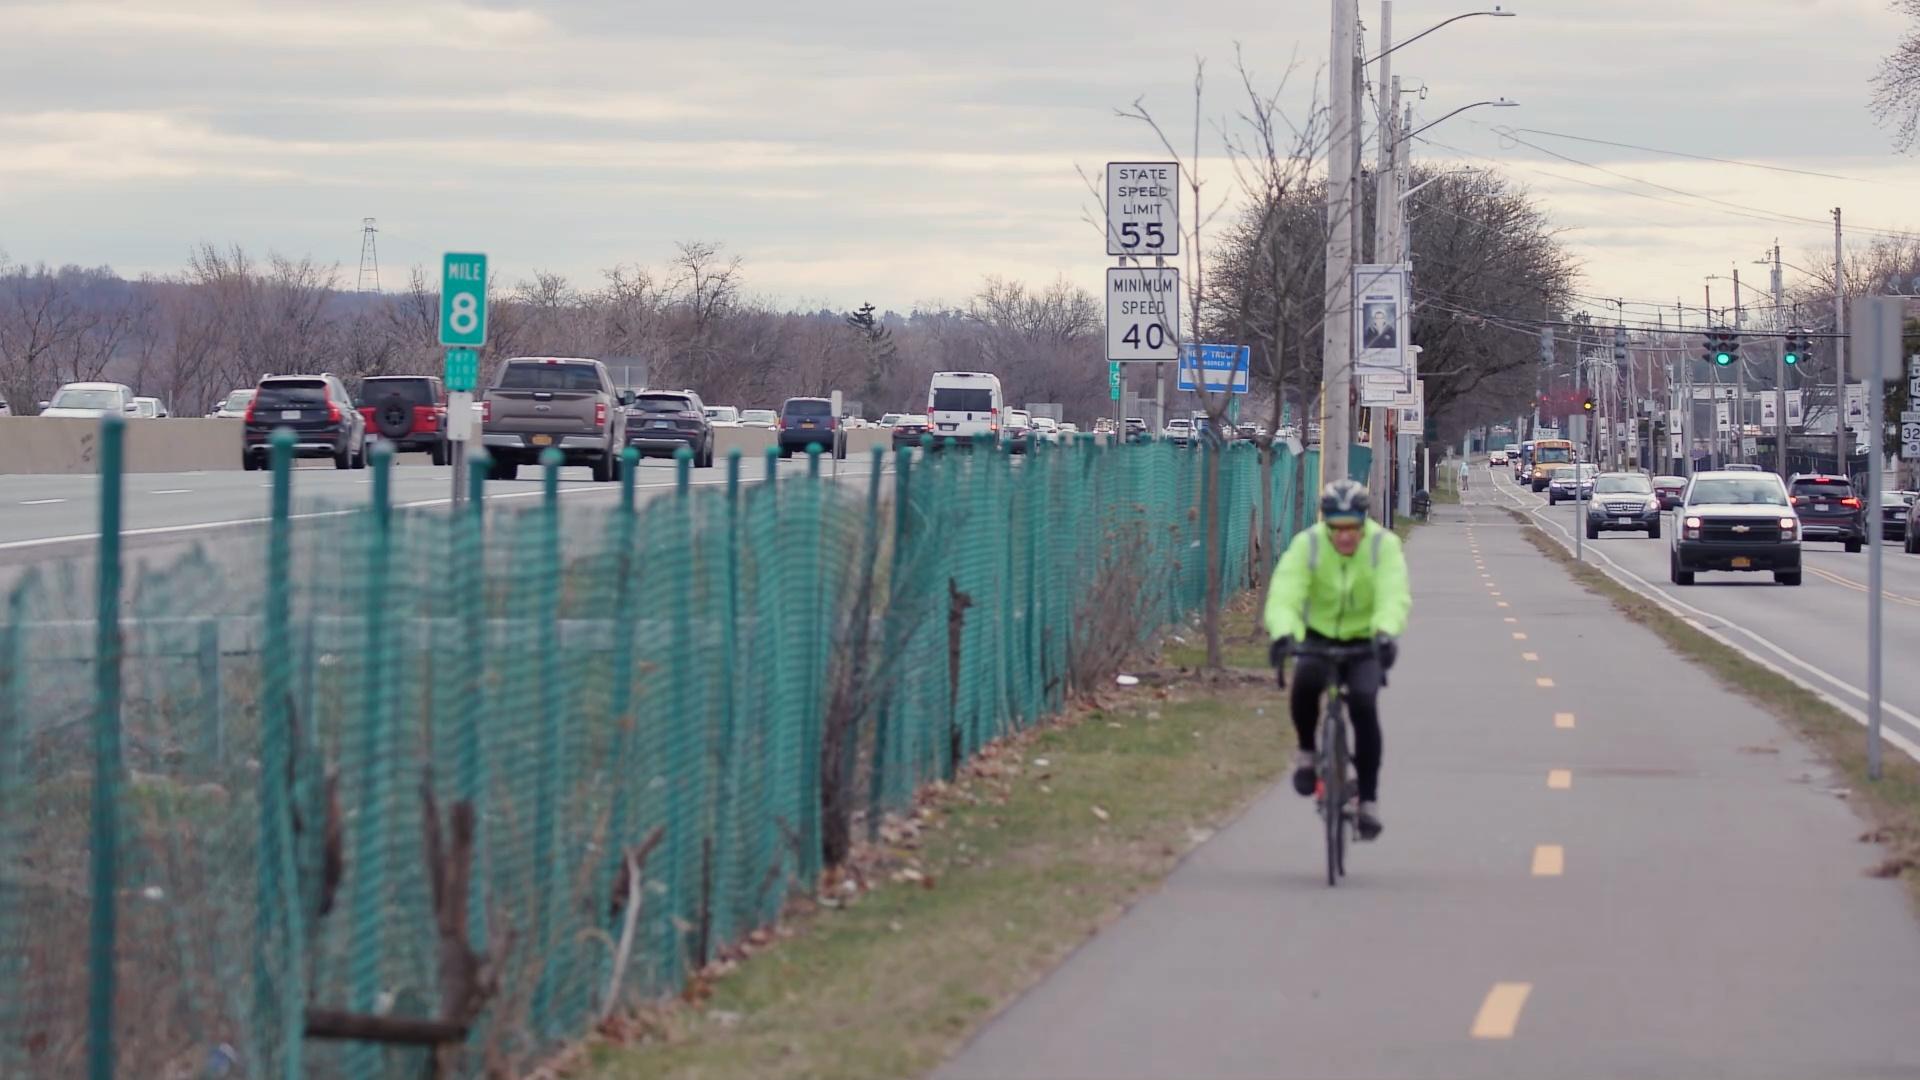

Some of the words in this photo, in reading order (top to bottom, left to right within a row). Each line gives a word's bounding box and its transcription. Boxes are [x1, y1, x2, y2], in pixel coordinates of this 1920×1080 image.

[1119, 169, 1167, 180] STATE
[1118, 186, 1168, 197] SPEED
[1123, 204, 1162, 215] LIMIT
[1121, 222, 1165, 248] 55
[448, 263, 481, 281] MILE
[1113, 278, 1172, 293] MINIMUM
[449, 292, 478, 334] 8
[1121, 300, 1165, 315] SPEED
[1121, 323, 1164, 350] 40
[1903, 427, 1920, 440] 32
